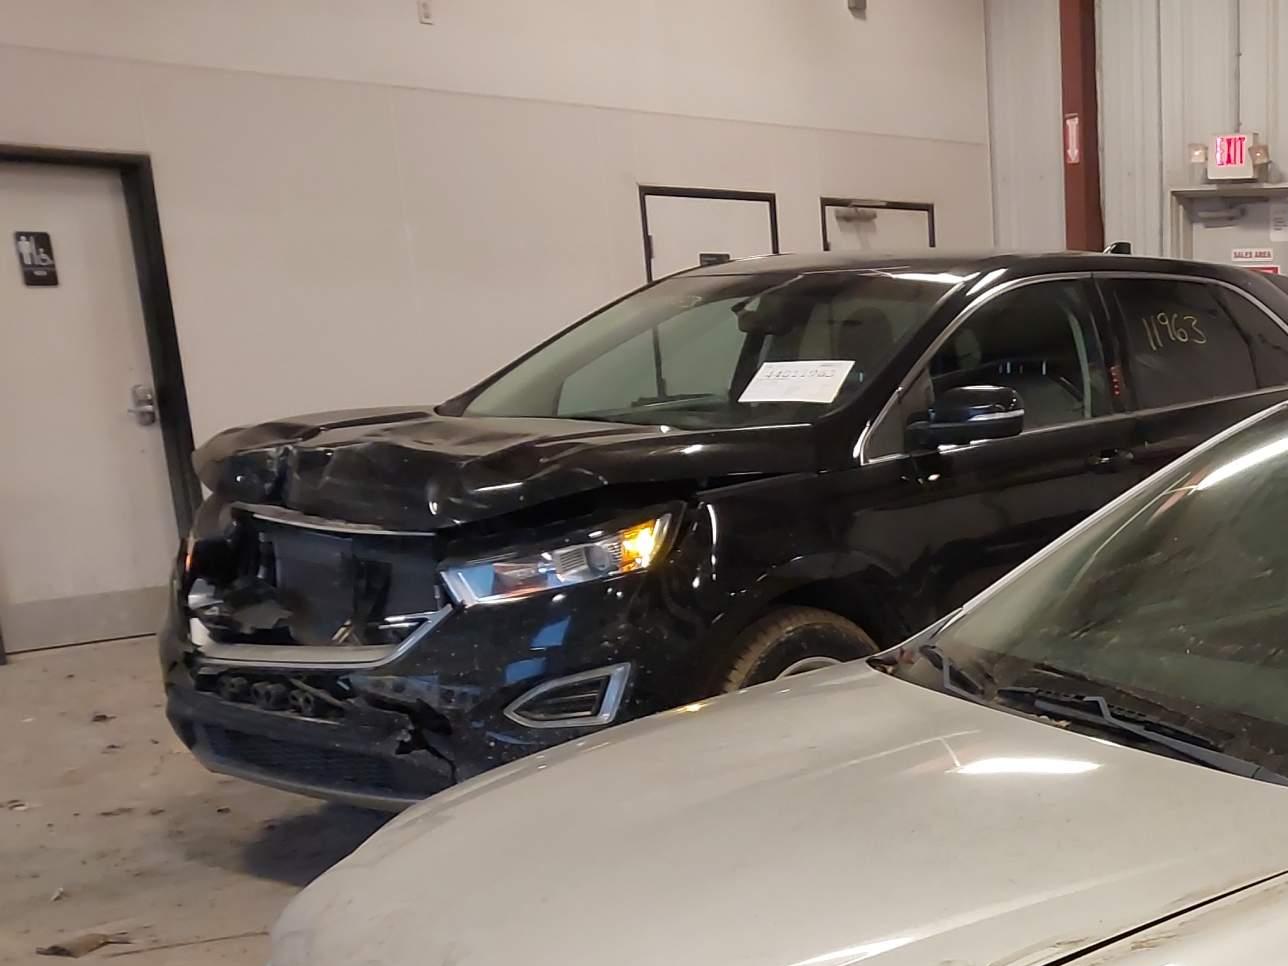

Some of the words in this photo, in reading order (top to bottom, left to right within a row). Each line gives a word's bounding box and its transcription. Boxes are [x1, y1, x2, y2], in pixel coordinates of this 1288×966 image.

[1216, 136, 1246, 166] EXIT
[1233, 251, 1253, 259] SALES
[1254, 251, 1272, 259] AREA
[1142, 312, 1207, 351] 11963
